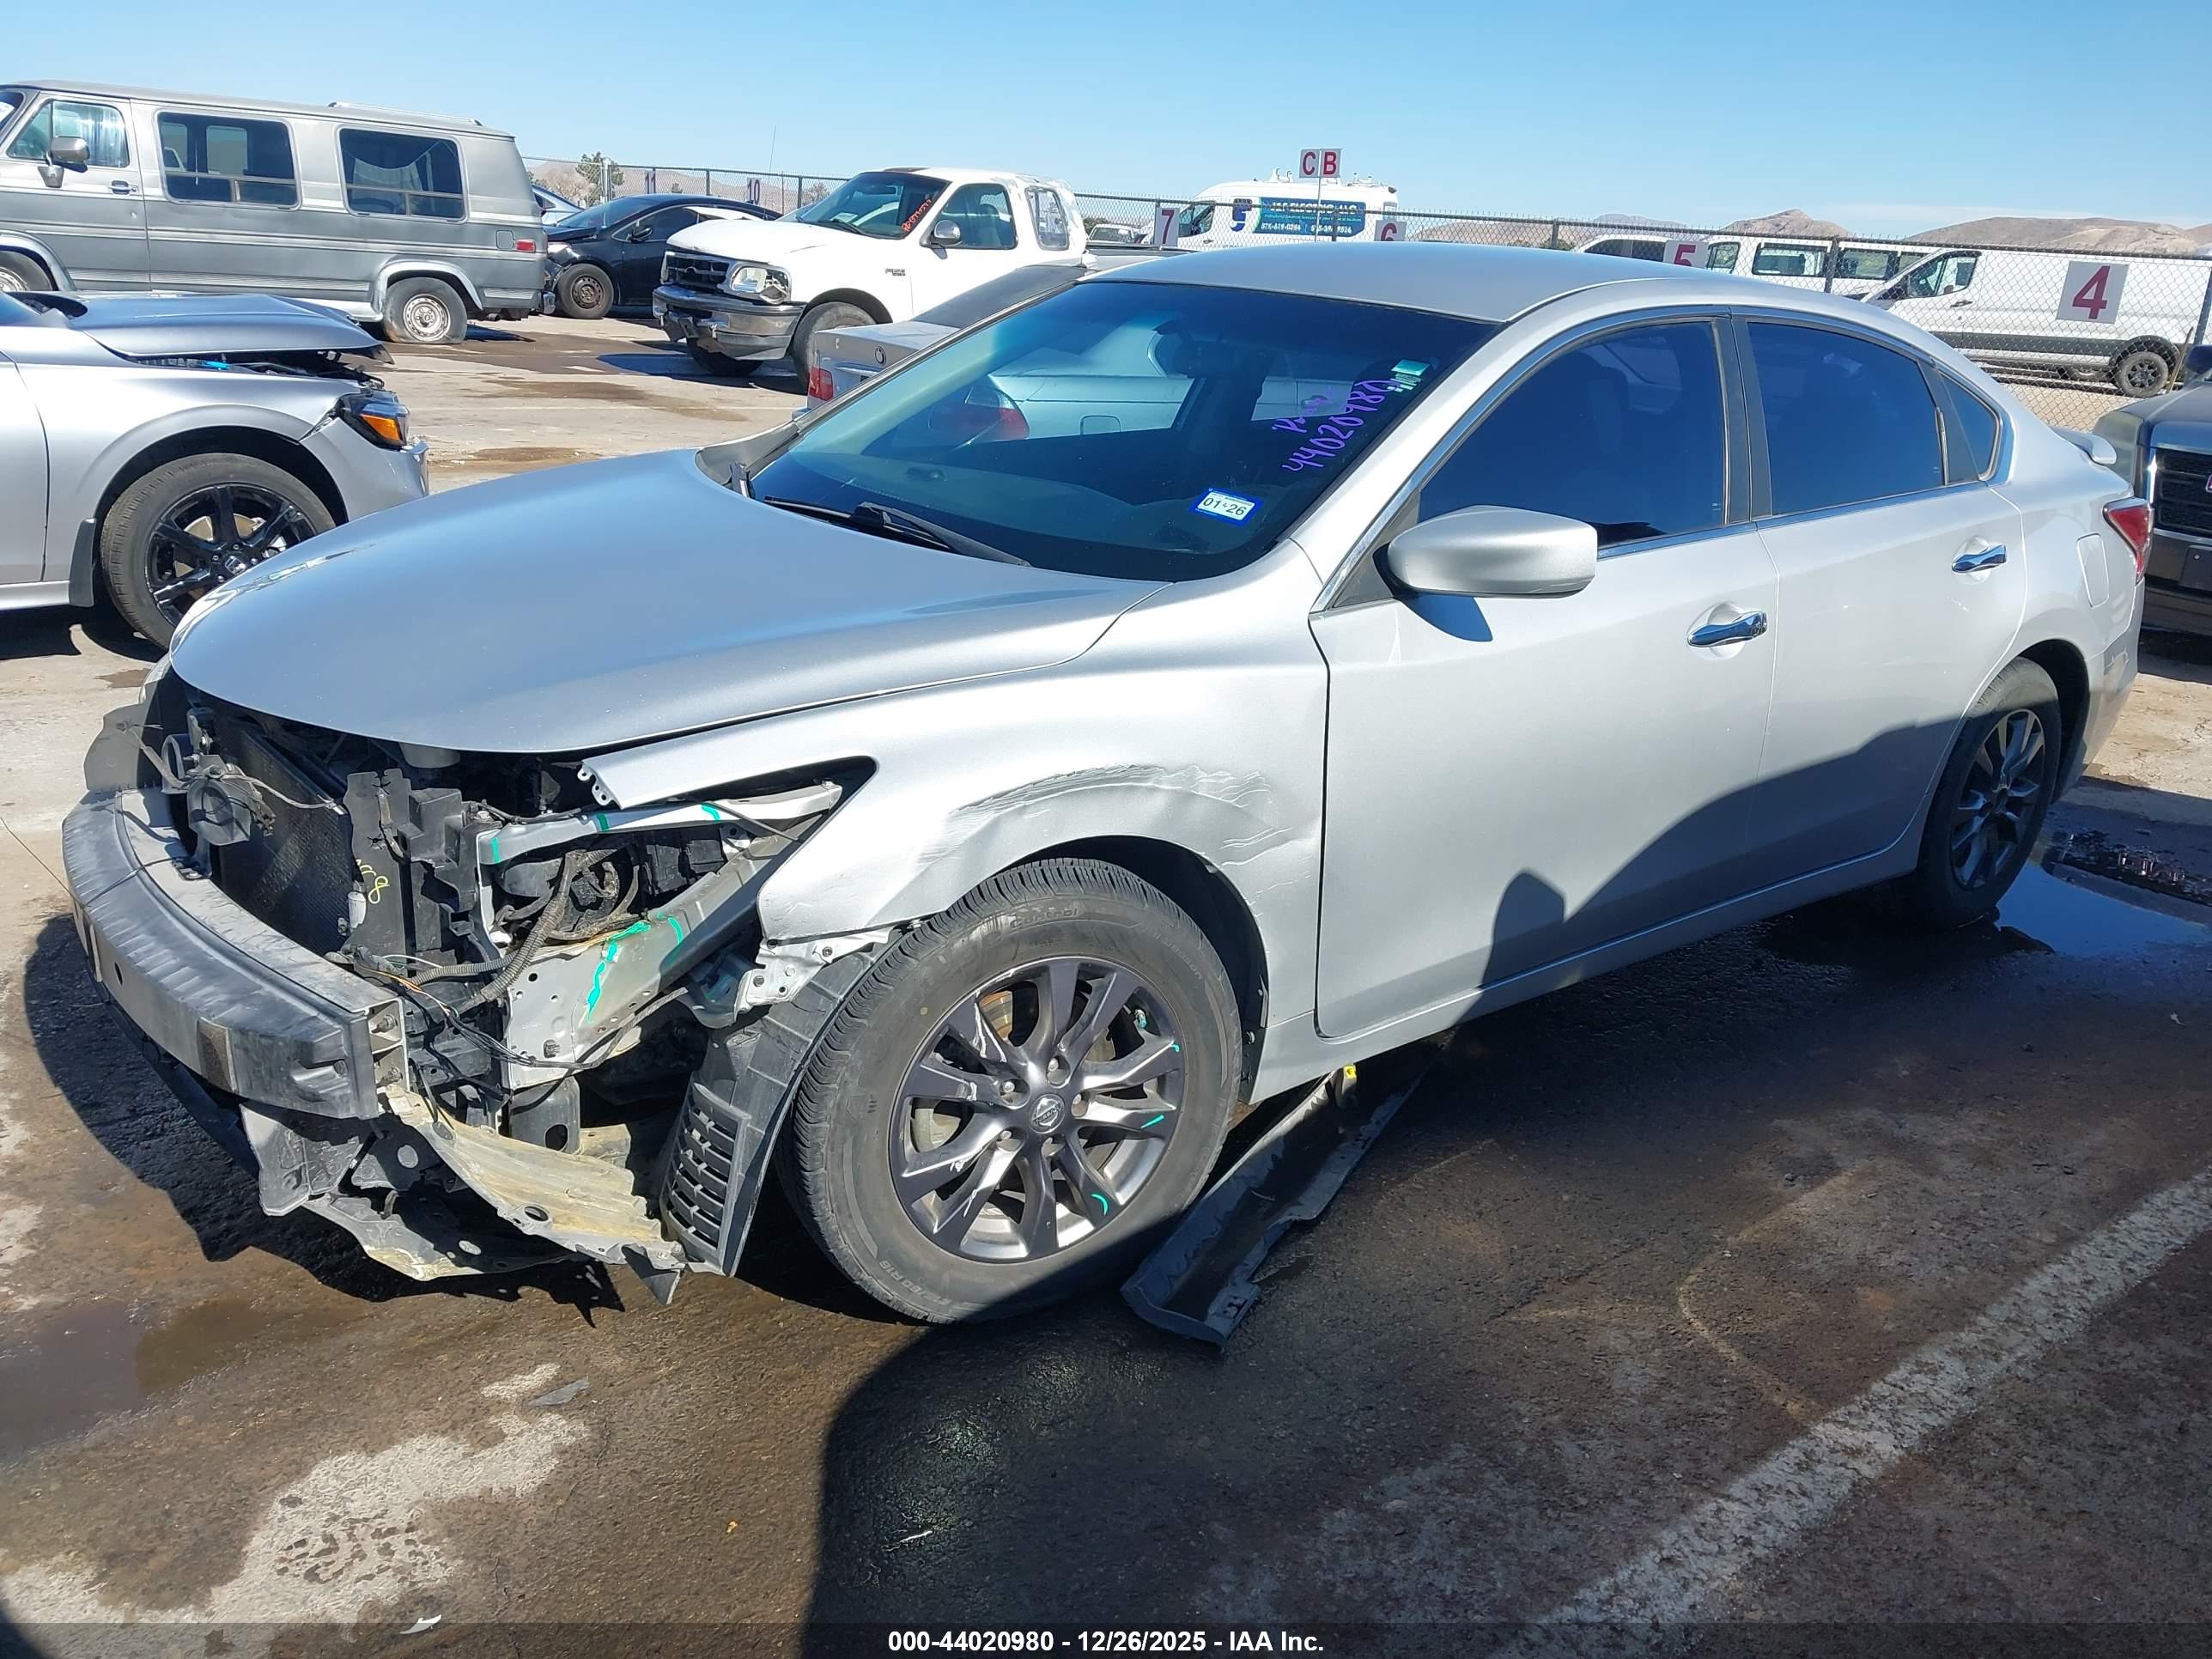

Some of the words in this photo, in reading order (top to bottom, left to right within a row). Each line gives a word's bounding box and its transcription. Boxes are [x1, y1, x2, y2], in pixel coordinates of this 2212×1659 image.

[1303, 151, 1316, 175] C
[1323, 151, 1336, 175] B
[747, 179, 760, 205] 10
[1161, 209, 1175, 245] 7
[2072, 265, 2111, 319] 4
